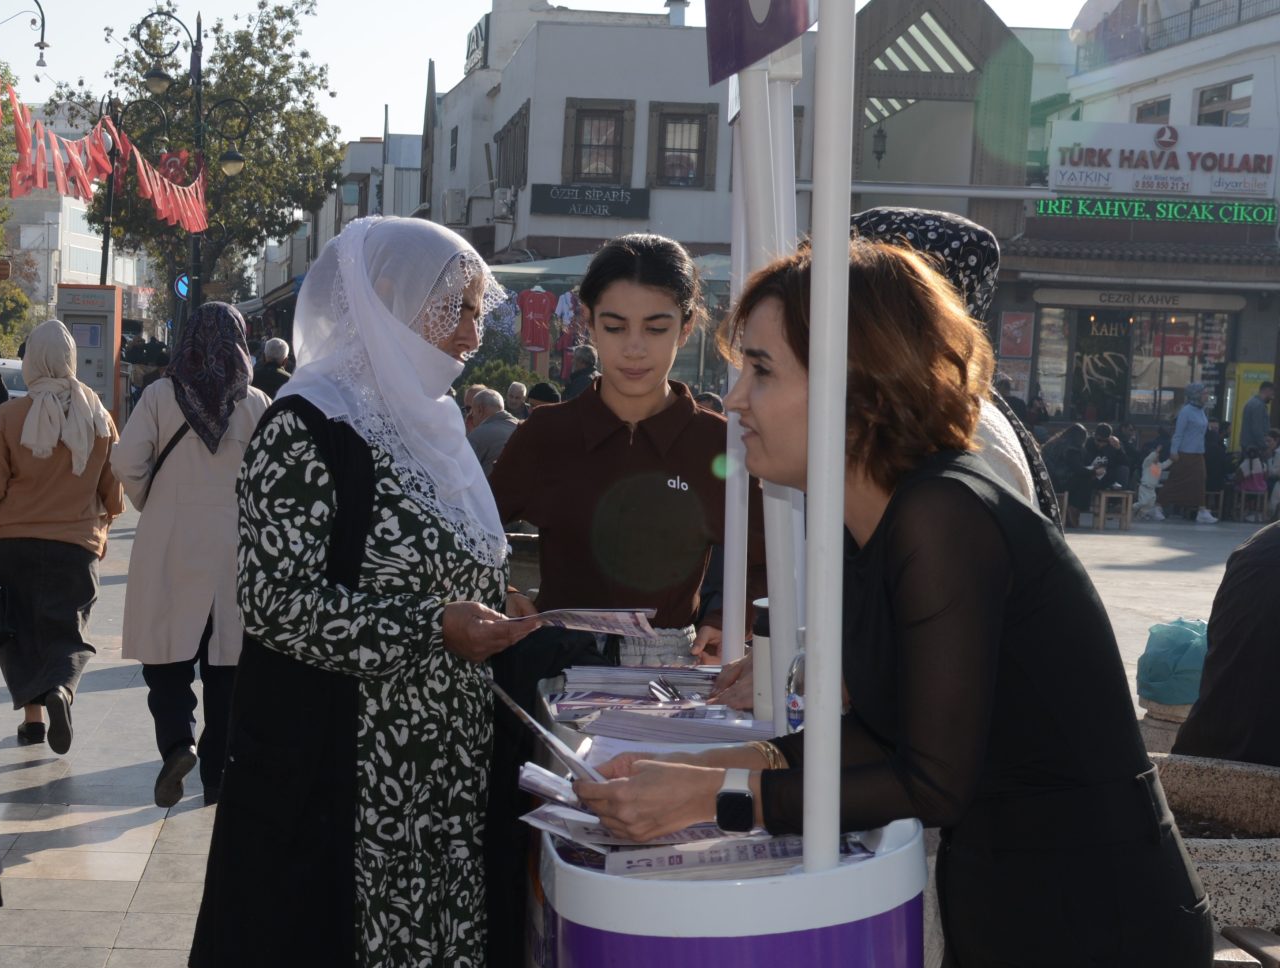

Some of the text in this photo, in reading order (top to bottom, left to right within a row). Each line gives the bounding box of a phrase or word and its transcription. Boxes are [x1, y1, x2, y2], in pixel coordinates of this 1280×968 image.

[1058, 142, 1273, 174] TÜRK HAVA YOLLARI
[1058, 169, 1112, 183] YATKIN
[1214, 175, 1268, 190] diyarbilet
[549, 186, 632, 205] ÖZEL SİPARİŞ
[568, 203, 612, 216] ALINIR
[1156, 202, 1215, 221] SICAK
[1137, 293, 1180, 306] KAHVE
[667, 475, 689, 491] alo
